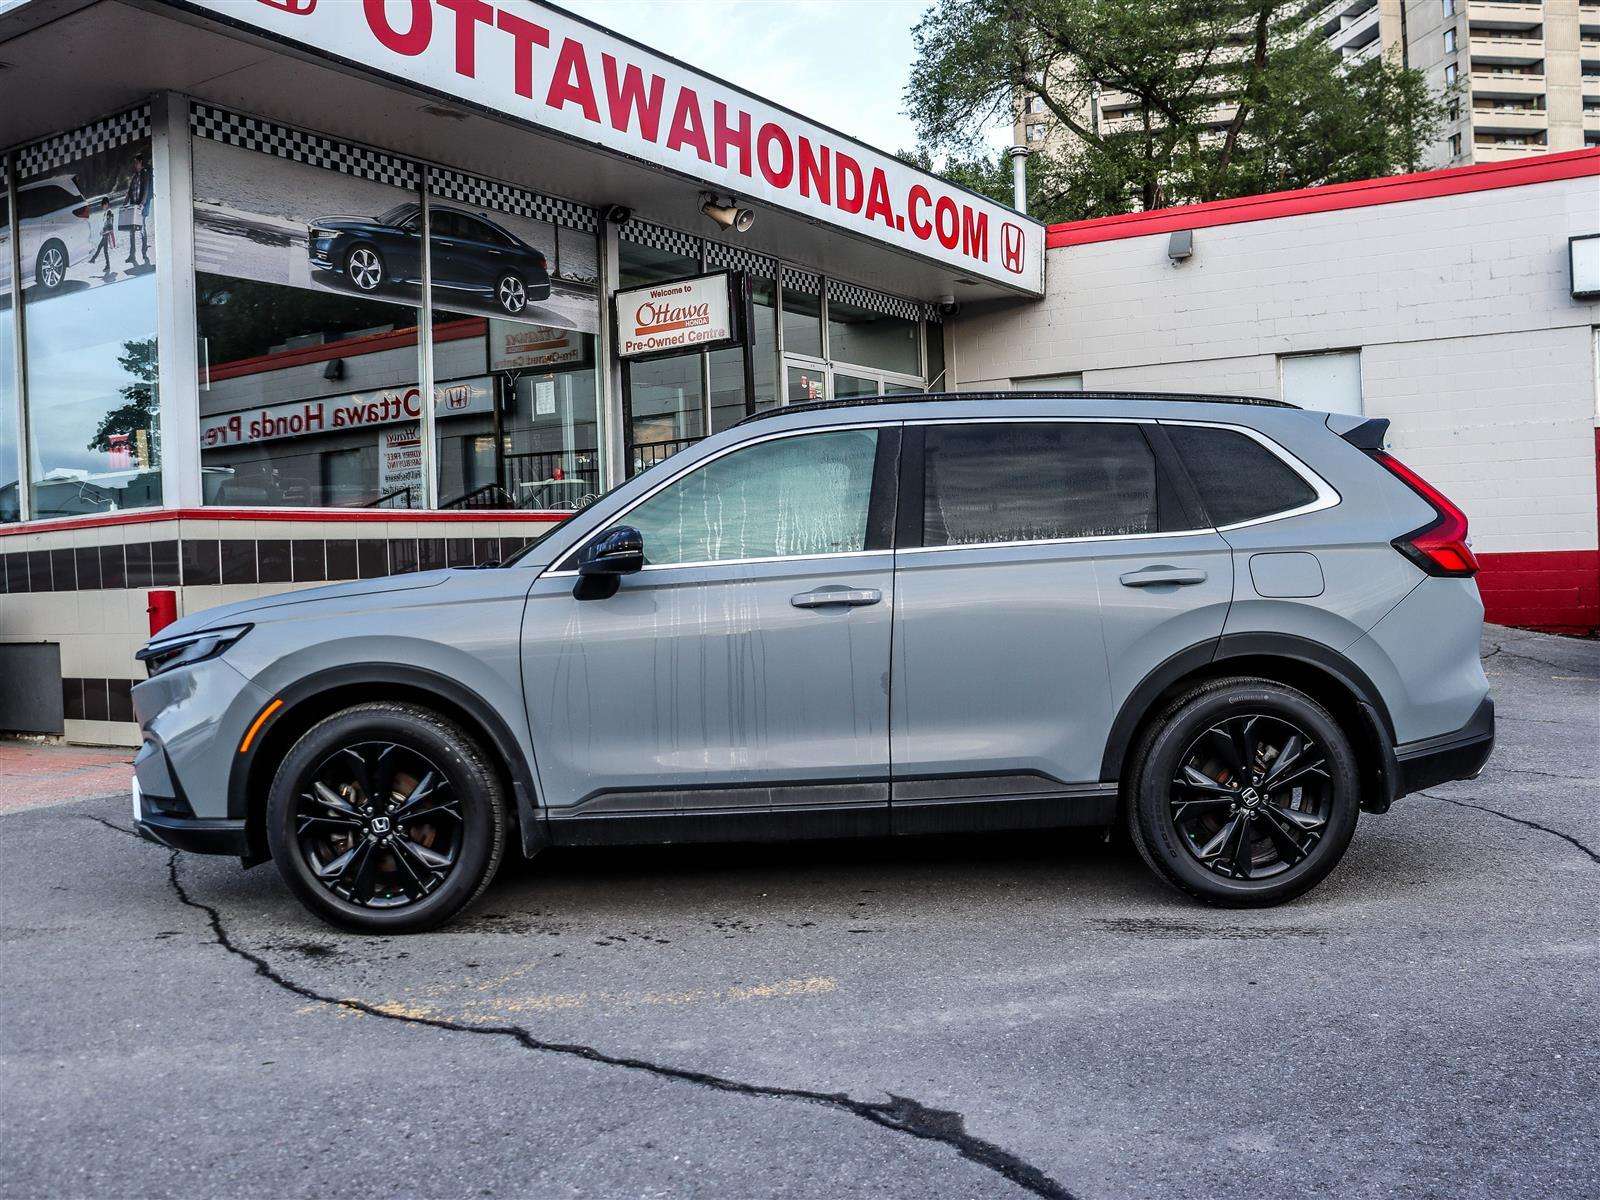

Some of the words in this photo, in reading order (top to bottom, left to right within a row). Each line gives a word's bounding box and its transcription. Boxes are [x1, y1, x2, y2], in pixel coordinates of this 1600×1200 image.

[363, 0, 988, 263] OTTAWAHONDA.COM
[650, 285, 682, 299] Welcome
[684, 284, 692, 293] to
[635, 301, 710, 327] Ottawa
[685, 317, 708, 327] HONDA
[625, 333, 685, 352] Pre-Owned
[687, 327, 726, 343] Centre
